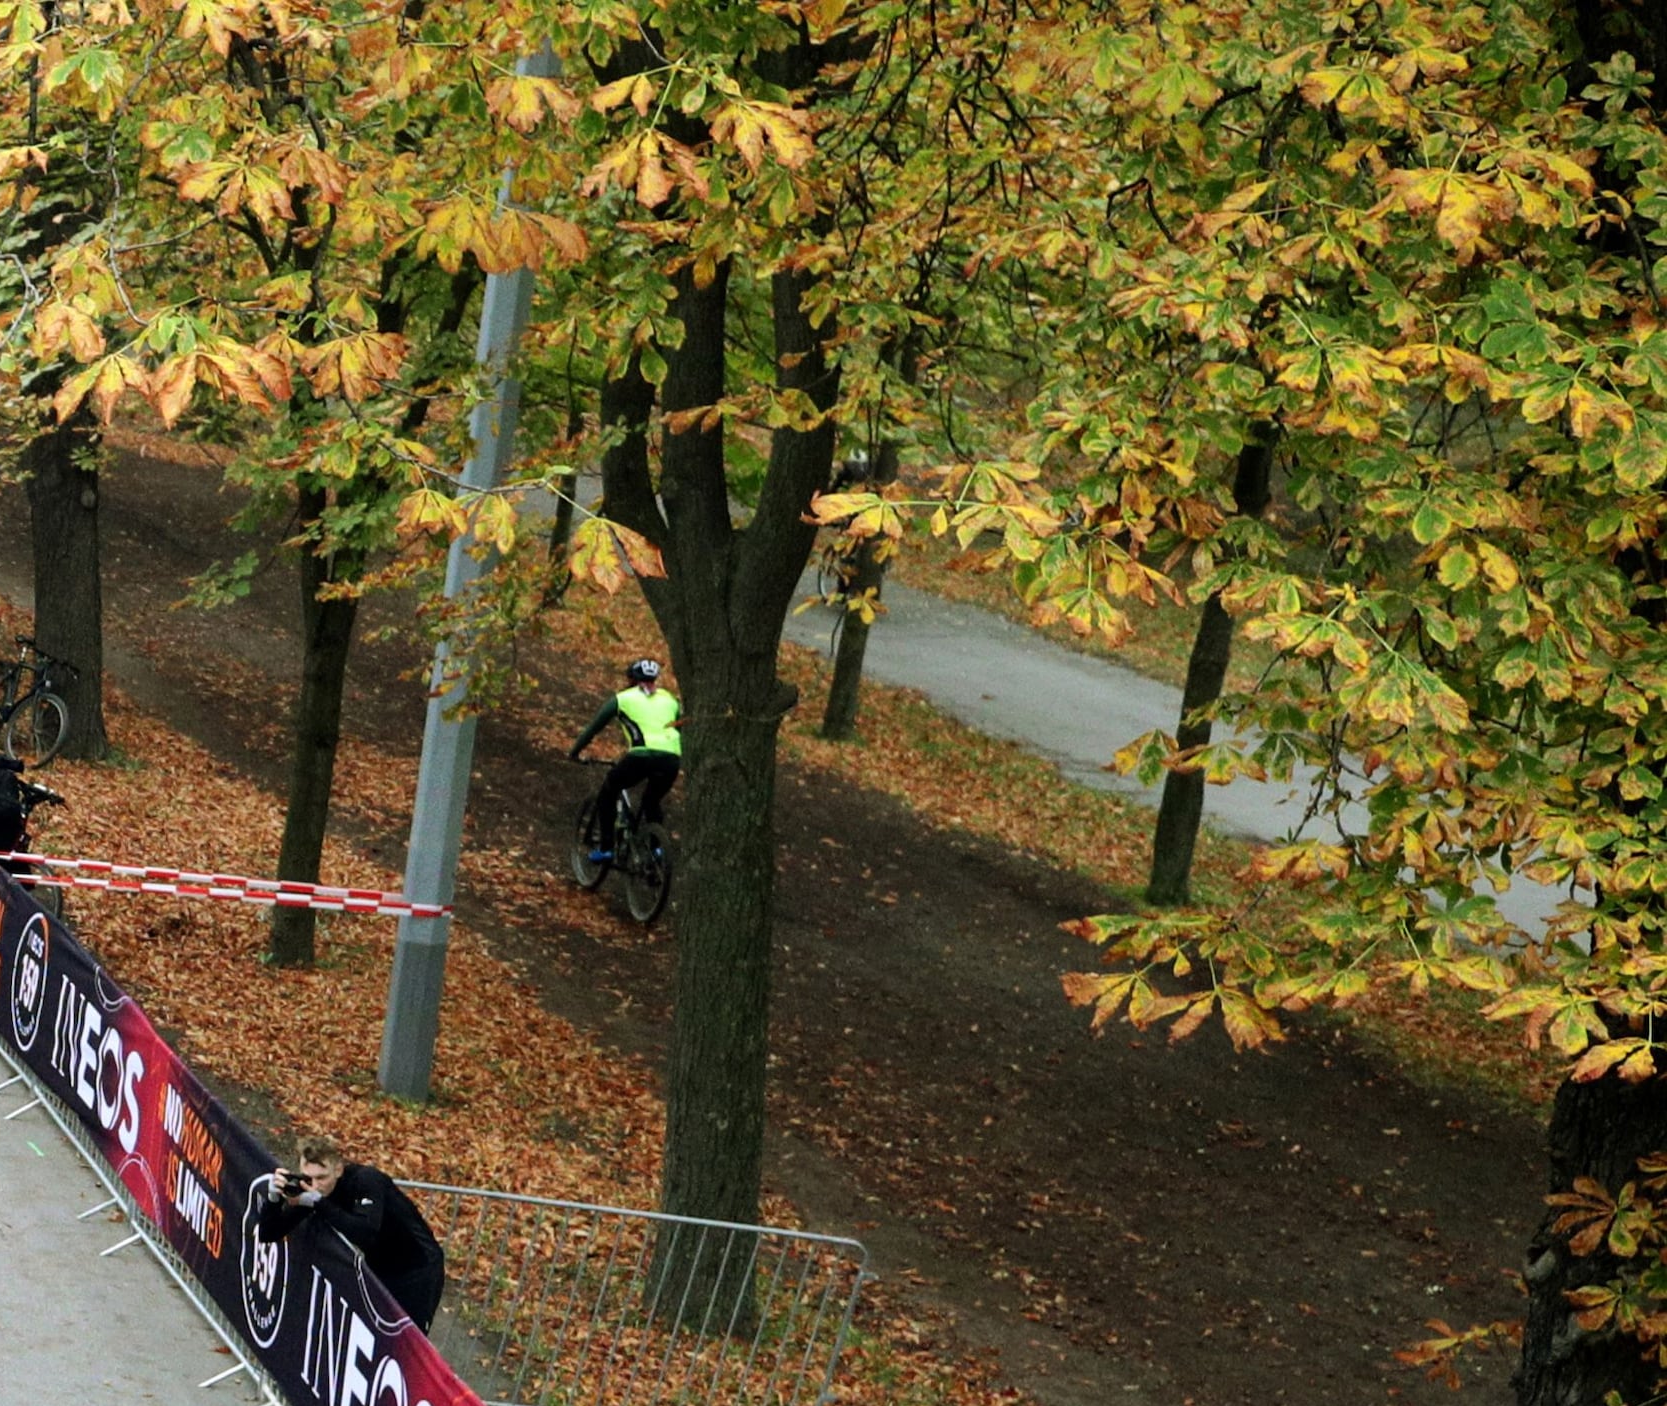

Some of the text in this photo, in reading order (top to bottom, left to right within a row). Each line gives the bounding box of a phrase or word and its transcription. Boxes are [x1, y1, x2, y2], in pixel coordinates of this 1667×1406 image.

[51, 974, 145, 1154] INEOS
[158, 1081, 223, 1194] #NOHUMAN
[166, 1149, 224, 1259] ISLIMITED
